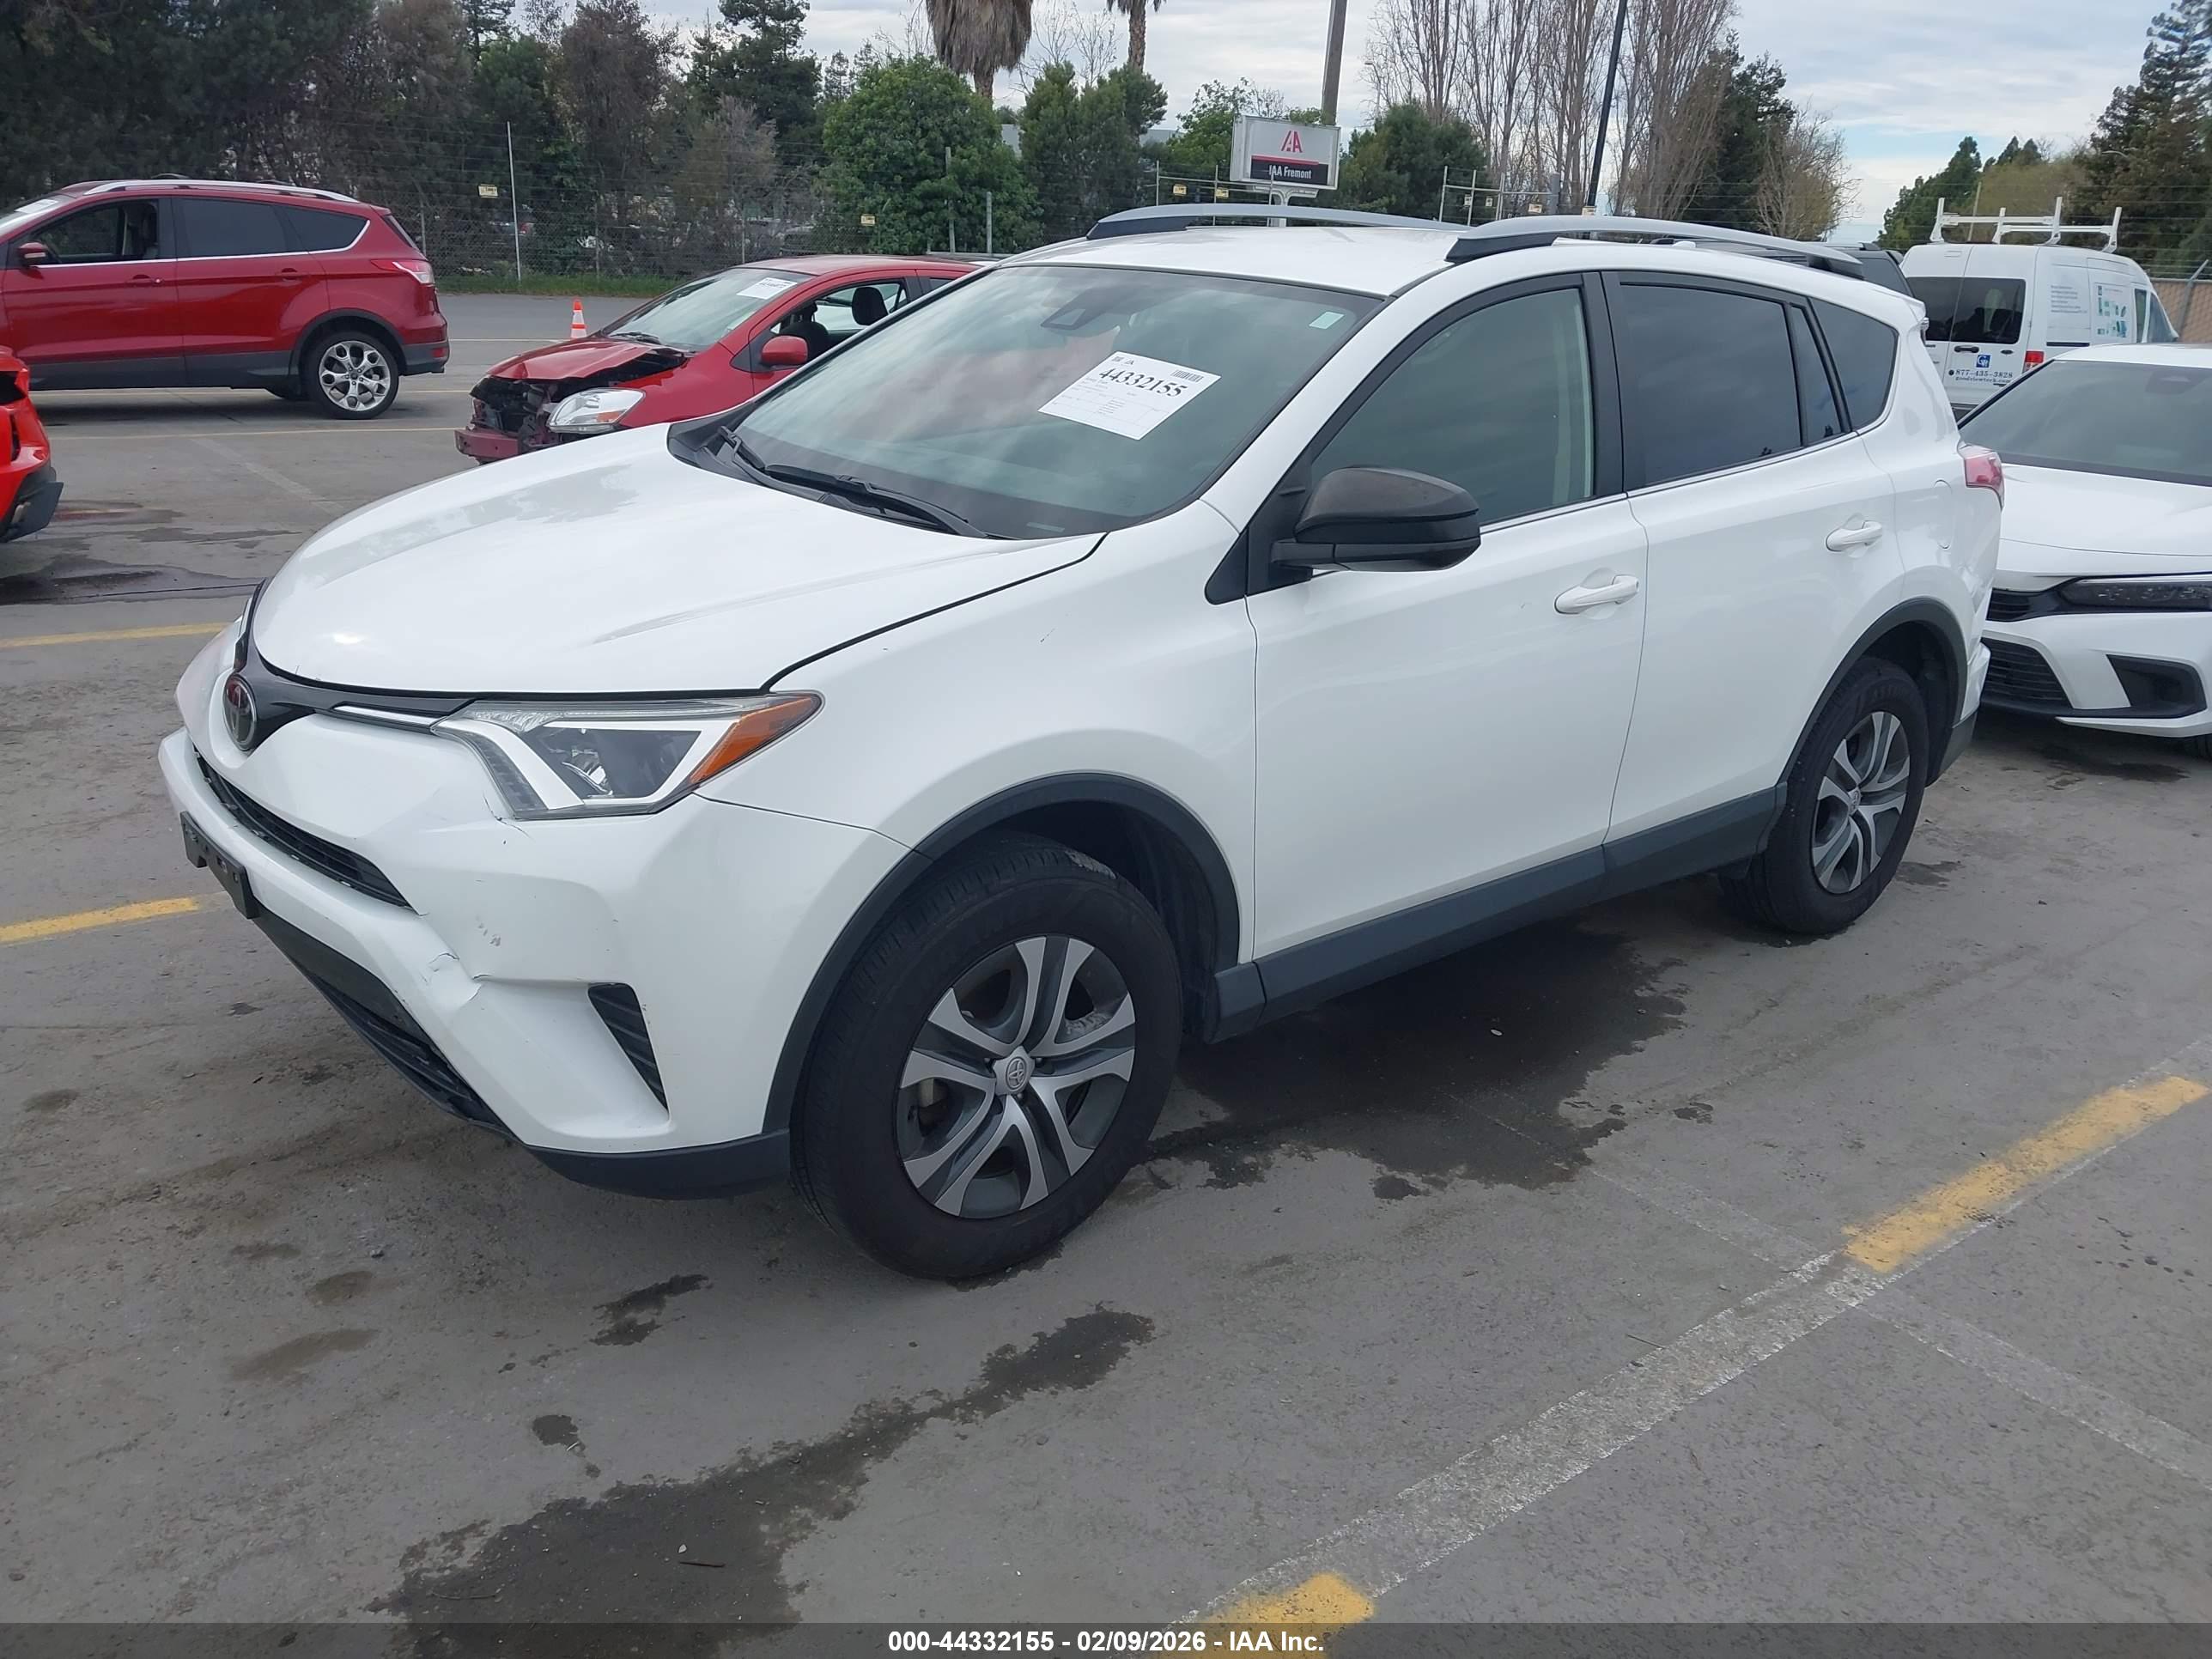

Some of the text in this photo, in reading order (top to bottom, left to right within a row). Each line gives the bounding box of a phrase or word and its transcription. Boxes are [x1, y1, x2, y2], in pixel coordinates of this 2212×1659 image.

[1269, 165, 1311, 179] IAA Fremont
[1099, 368, 1188, 395] 44332155
